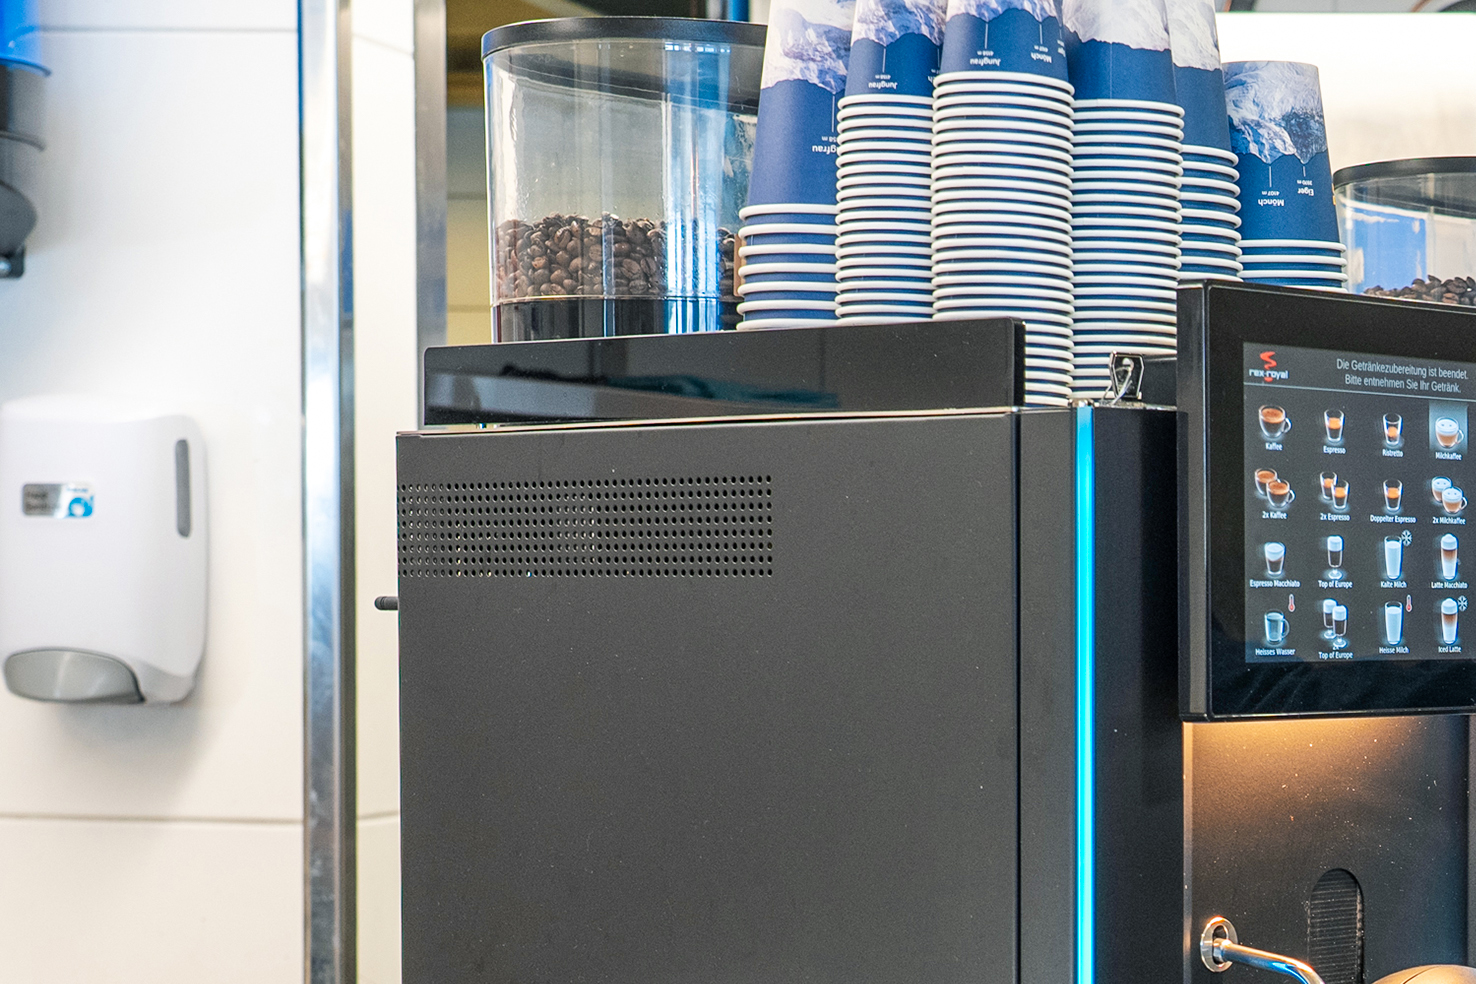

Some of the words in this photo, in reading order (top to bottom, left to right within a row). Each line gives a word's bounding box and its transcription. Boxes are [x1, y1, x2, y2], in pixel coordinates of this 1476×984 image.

[970, 57, 1001, 66] Jungfrau
[868, 80, 898, 90] Jungfrau
[812, 145, 838, 155] gfrau
[1297, 187, 1314, 196] Eiger
[1258, 199, 1285, 207] Mönch
[1337, 359, 1349, 369] Die
[1351, 360, 1427, 379] Getränkezubereitung
[1428, 367, 1437, 378] ist
[1438, 367, 1469, 380] beendet.
[1345, 374, 1362, 386] Bitte
[1363, 375, 1404, 389] entnehmen
[1406, 379, 1418, 390] Sie
[1420, 380, 1429, 390] Ihr
[1431, 382, 1461, 393] Getränk.
[1265, 442, 1283, 451] Kaffee
[1323, 446, 1347, 455] Espresso
[1383, 449, 1403, 457] Ristretto
[1435, 452, 1462, 461] Milchkaffee
[1262, 511, 1269, 519] 2x
[1270, 511, 1287, 519] Kaffee
[1320, 513, 1327, 521] 2x
[1328, 513, 1350, 522] Espresso
[1370, 515, 1394, 524] Doppelter
[1394, 515, 1417, 524] Espresso
[1432, 516, 1439, 524] 2x
[1439, 517, 1466, 525] Milchkaffee
[1249, 580, 1273, 589] Espresso
[1273, 580, 1300, 588] Macchiato
[1318, 581, 1329, 589] Top
[1329, 580, 1334, 588] of
[1334, 581, 1353, 589] Europe
[1255, 648, 1276, 656] Heisses
[1276, 648, 1296, 656] Wasser
[1379, 646, 1395, 654] Heisse
[1395, 646, 1410, 654] Milch
[1335, 652, 1354, 660] Europe
